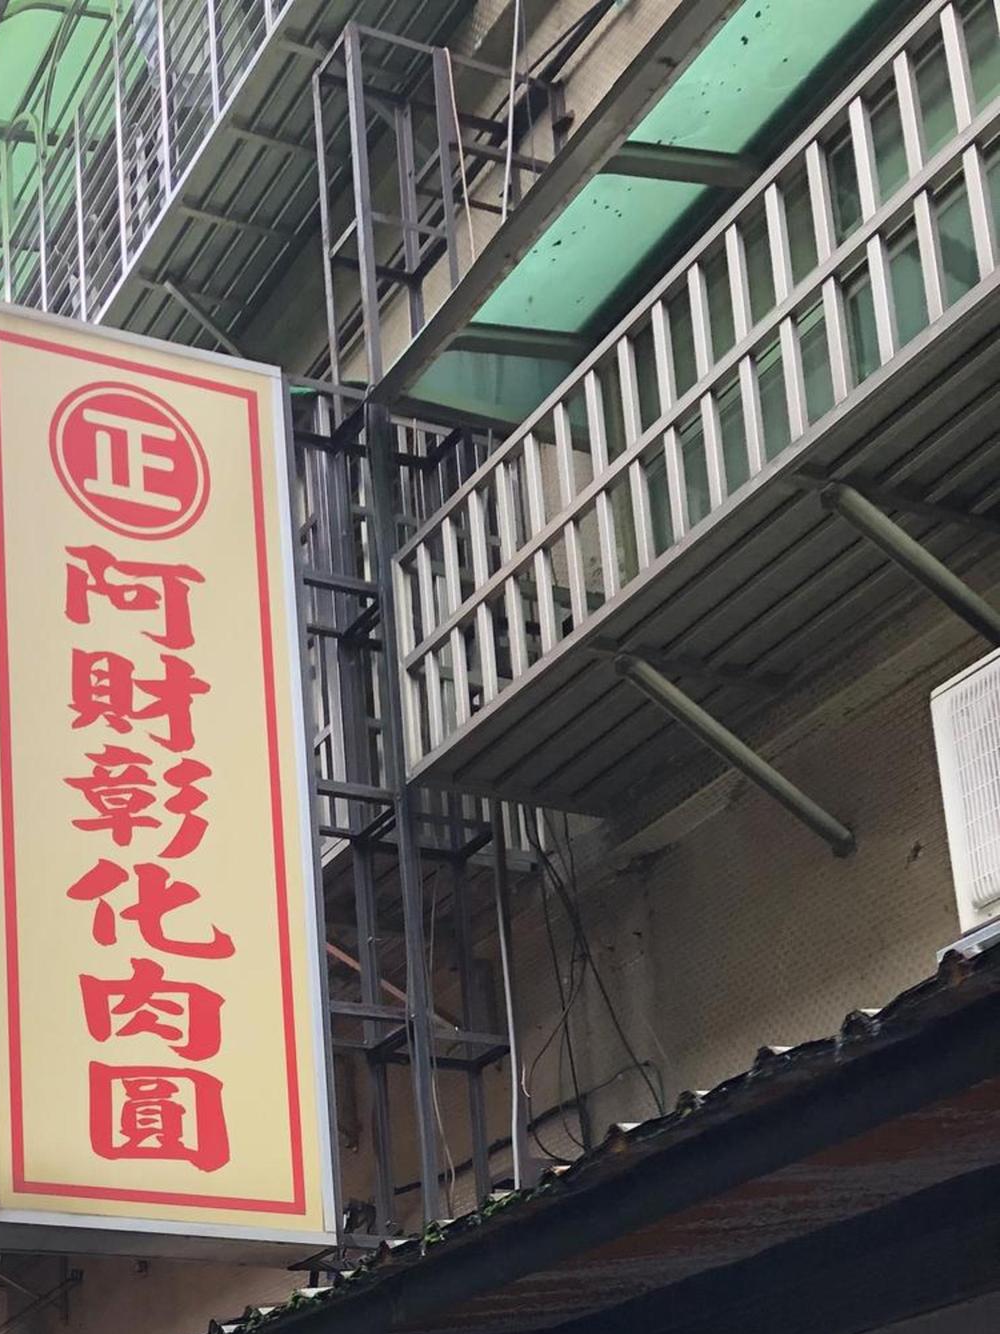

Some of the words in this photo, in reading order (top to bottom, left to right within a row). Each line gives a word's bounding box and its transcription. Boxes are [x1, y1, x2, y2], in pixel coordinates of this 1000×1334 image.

[64, 544, 235, 1172] 阿財彰化肉圓
